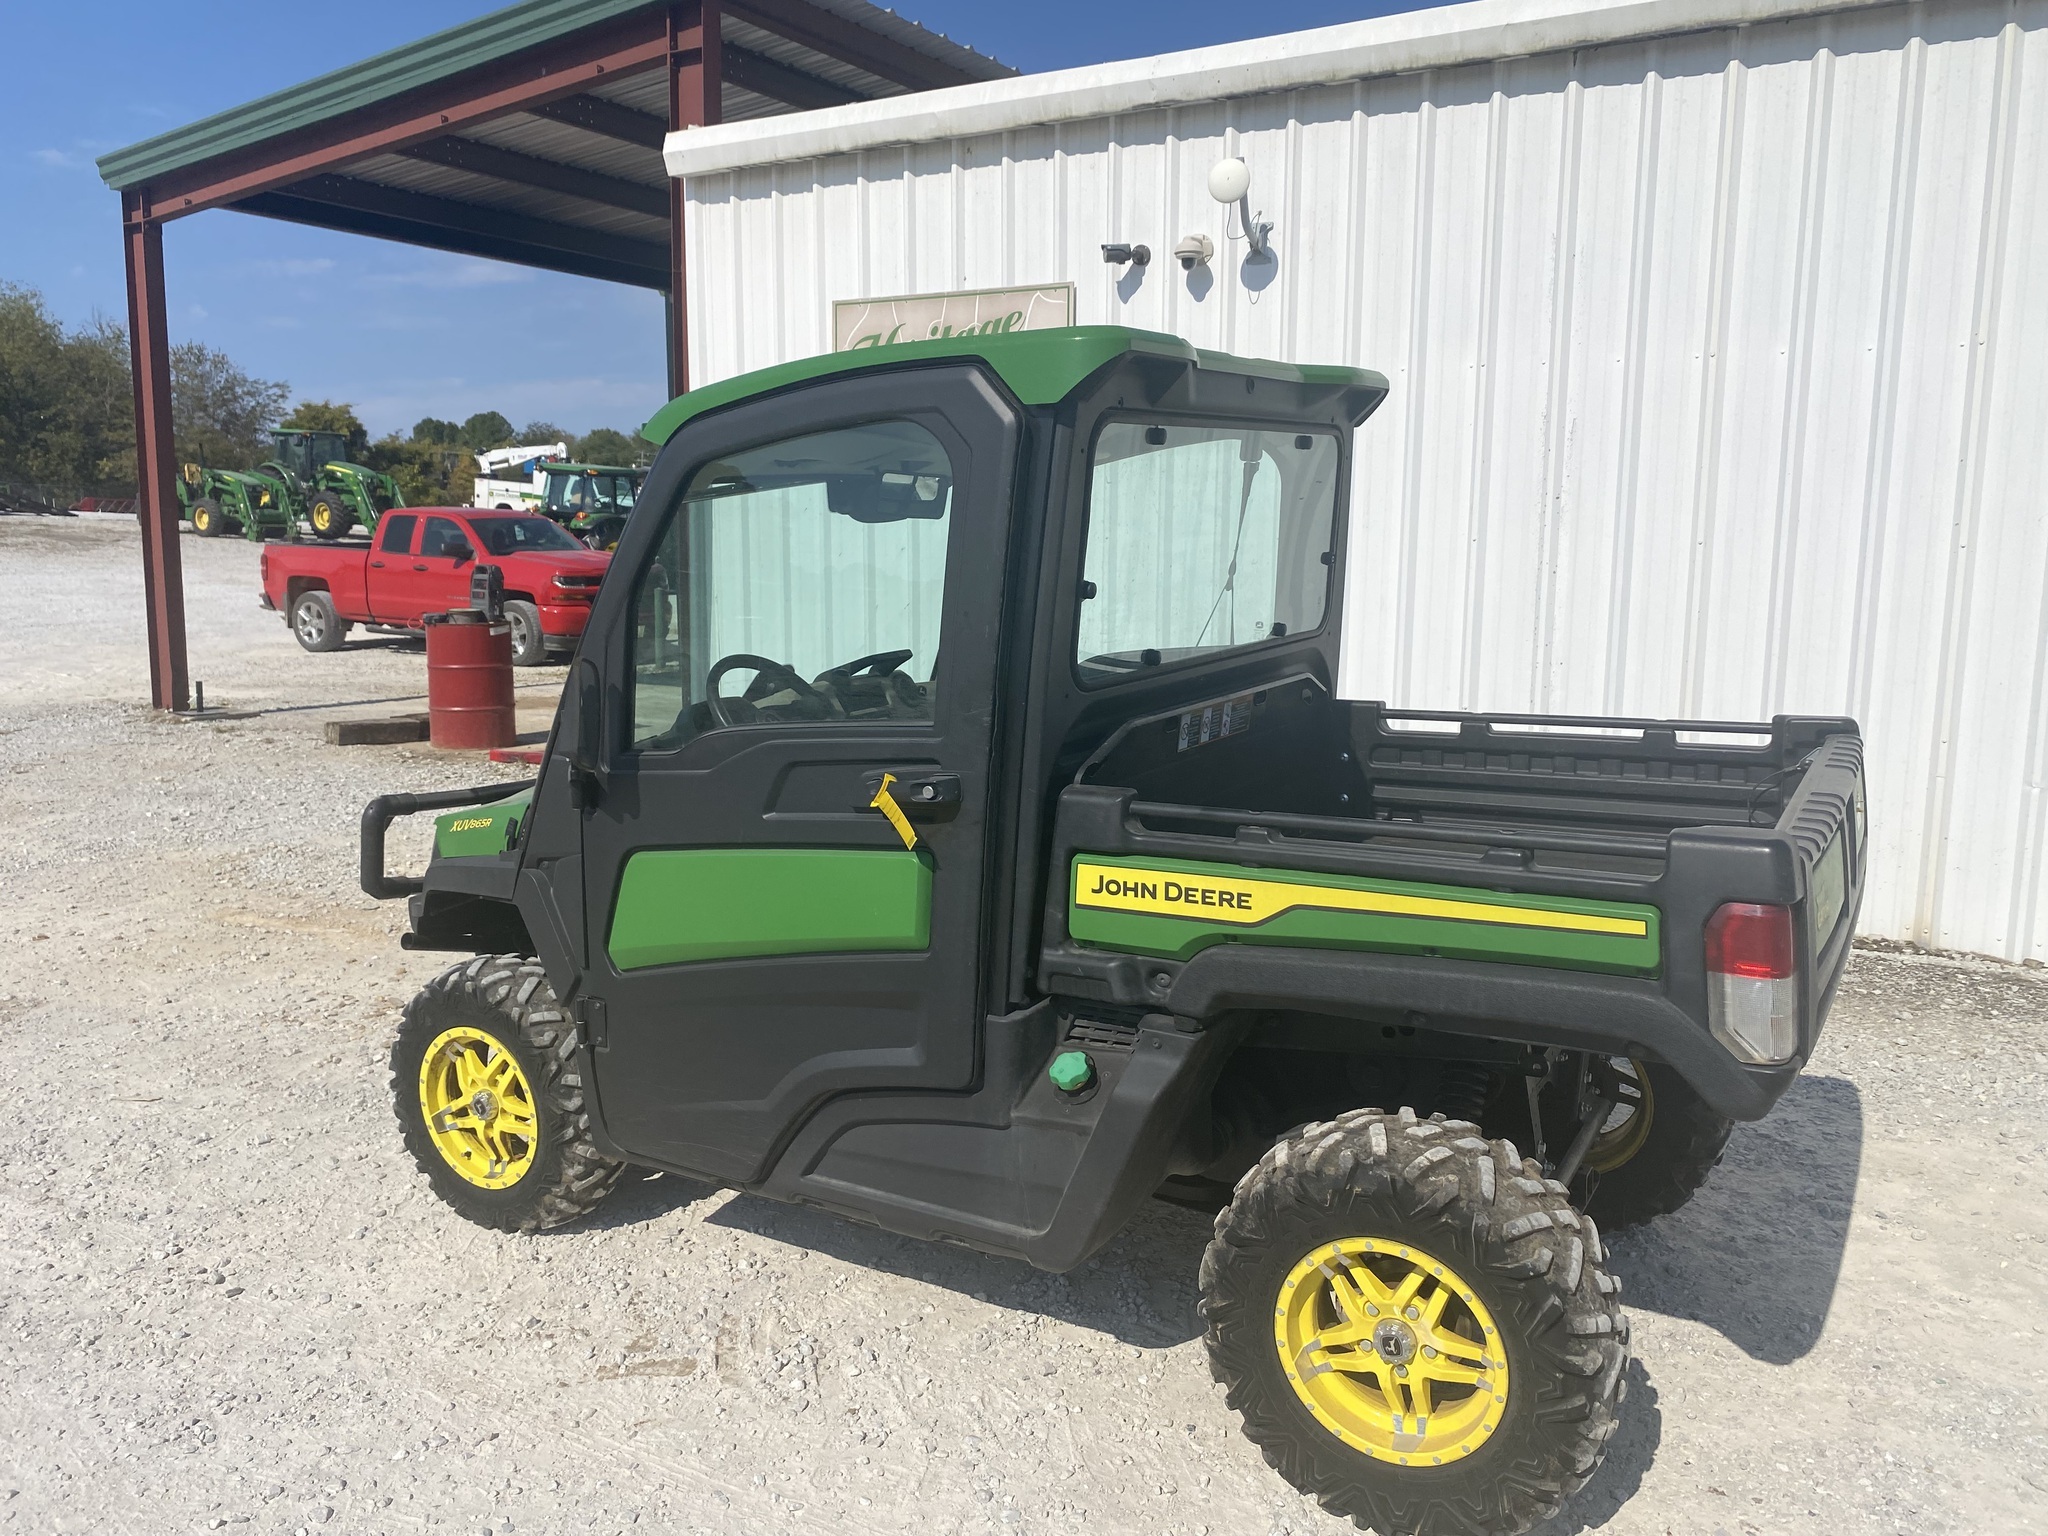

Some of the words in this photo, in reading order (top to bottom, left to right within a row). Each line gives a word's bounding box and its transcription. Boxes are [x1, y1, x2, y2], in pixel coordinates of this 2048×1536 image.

[449, 818, 493, 833] XUV865R
[1091, 875, 1157, 900] JOHN
[1164, 881, 1252, 910] DEERE
